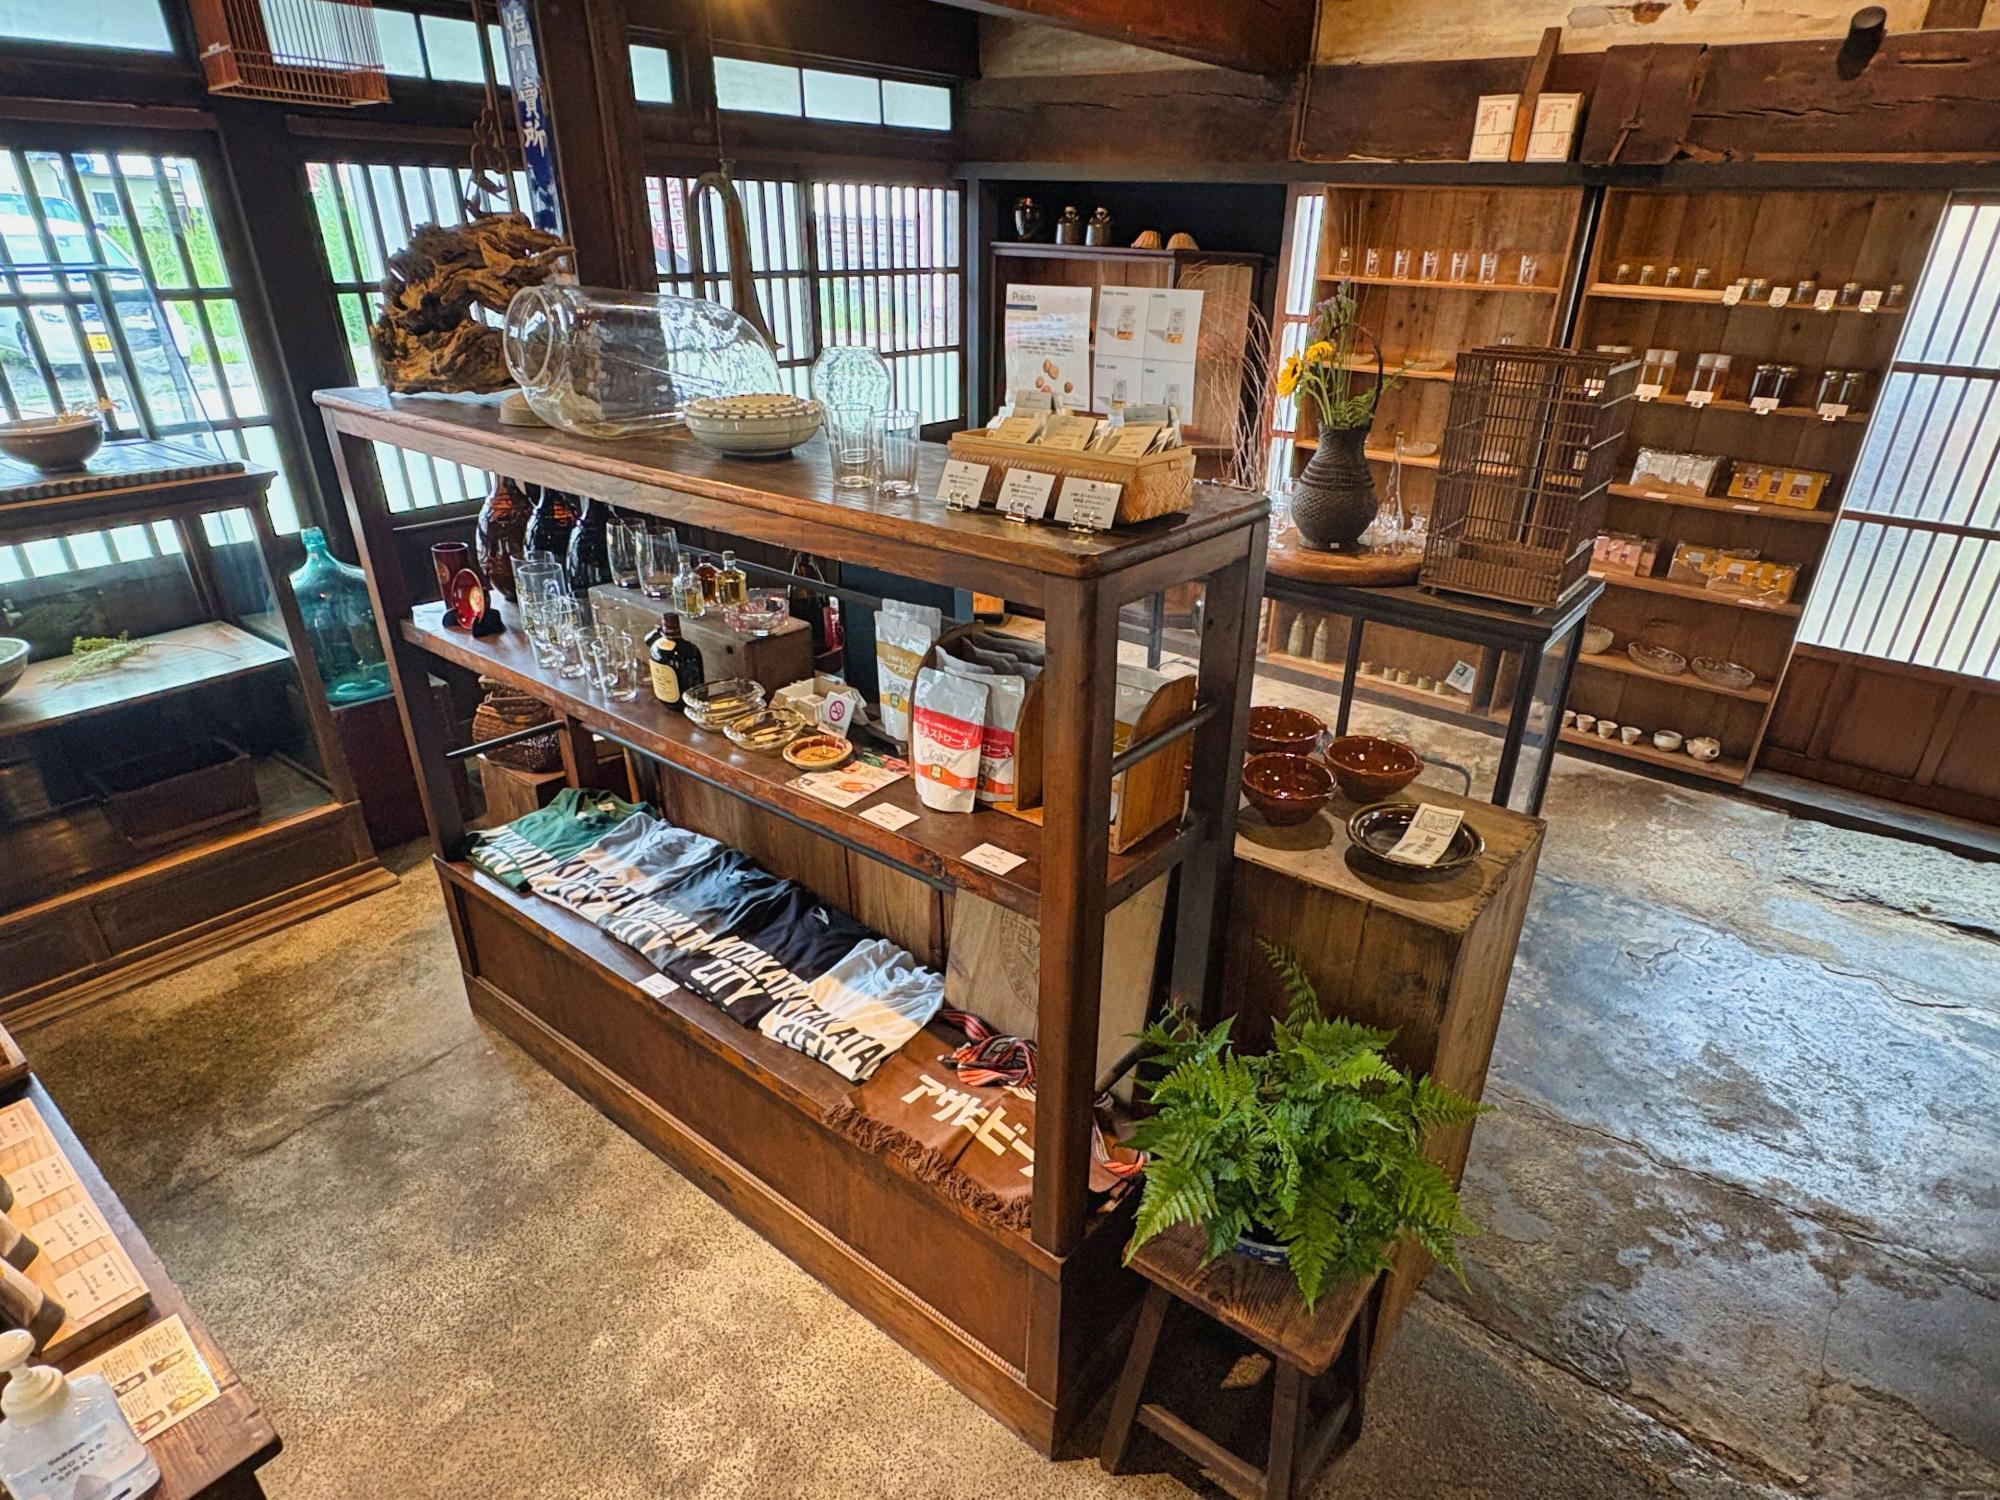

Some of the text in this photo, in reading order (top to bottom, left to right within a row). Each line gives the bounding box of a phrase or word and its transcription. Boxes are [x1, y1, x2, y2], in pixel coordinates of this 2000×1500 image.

[690, 959, 764, 1006] CITY
[776, 991, 886, 1073] KITAKATA
[901, 1074, 1034, 1177] アサヒビー
[40, 1460, 75, 1484] HAND
[57, 1456, 95, 1481] SPRAY
